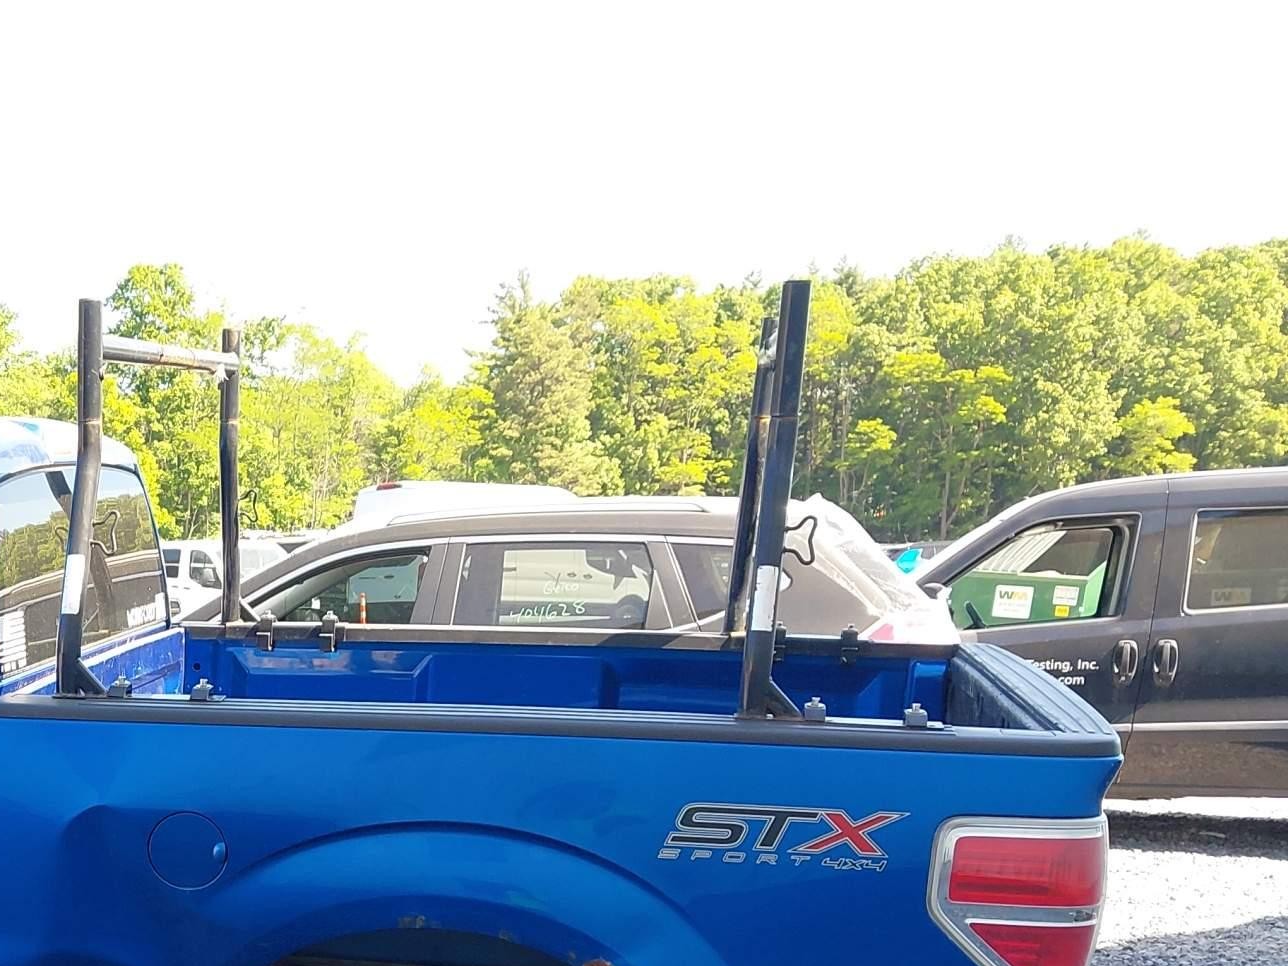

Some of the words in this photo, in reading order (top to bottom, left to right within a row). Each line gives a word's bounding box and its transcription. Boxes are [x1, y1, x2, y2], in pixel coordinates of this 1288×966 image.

[1077, 659, 1100, 671] Inc.
[663, 802, 912, 859] STX
[657, 848, 811, 867] SPORT
